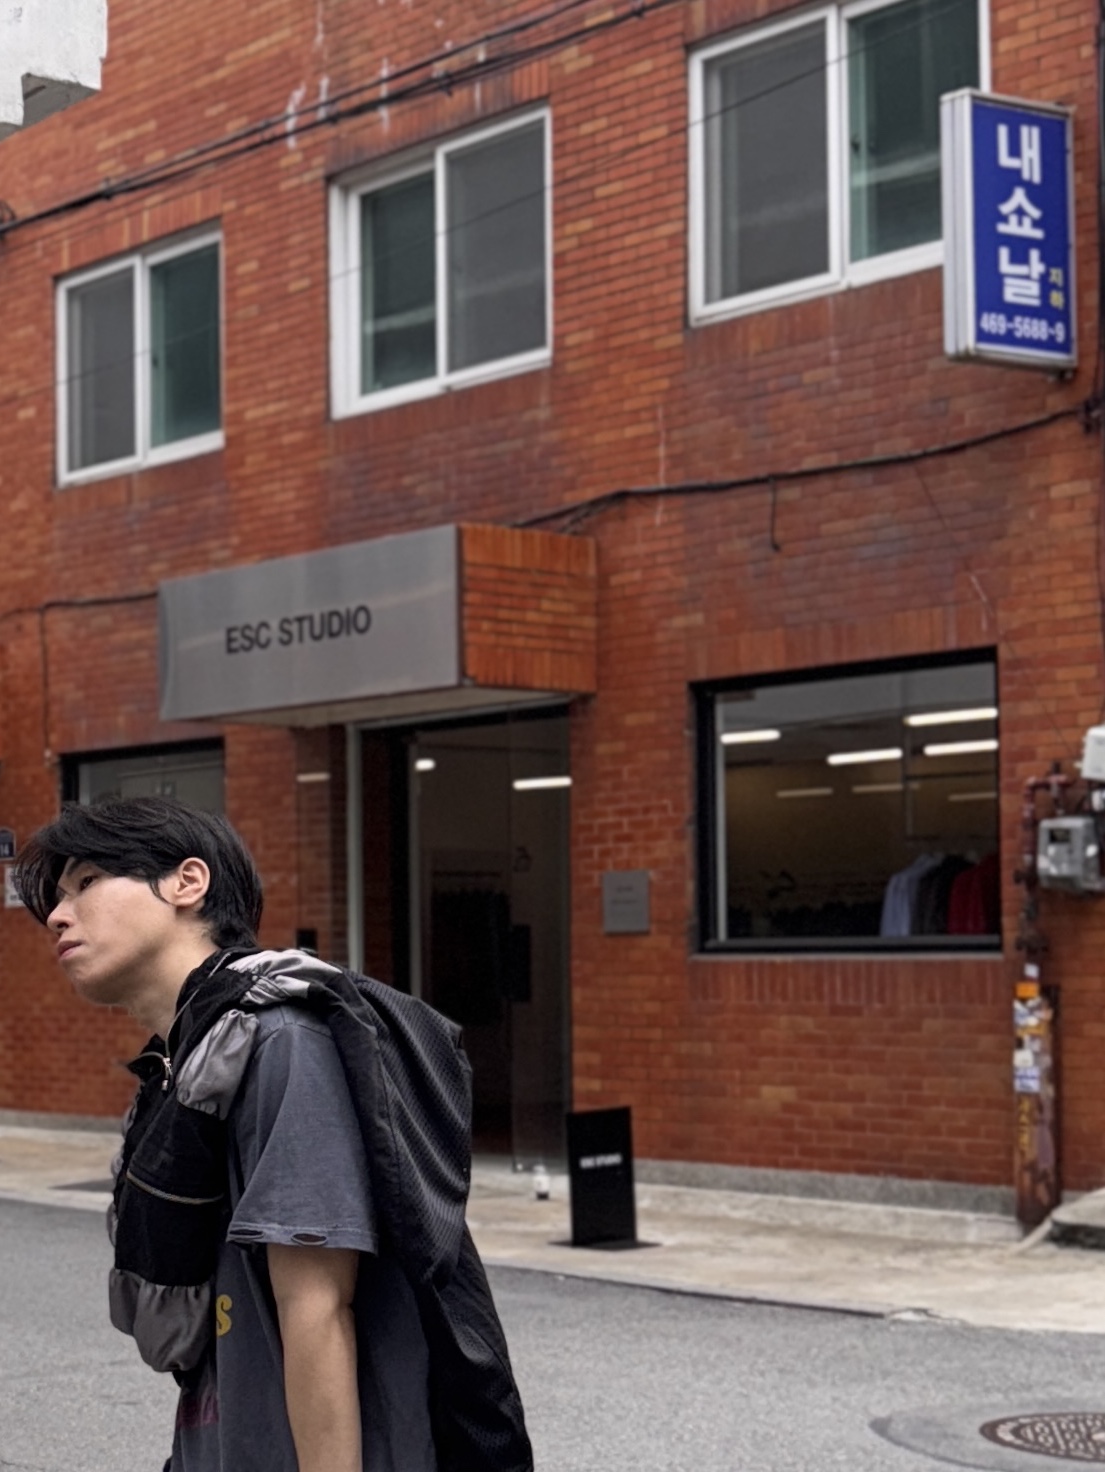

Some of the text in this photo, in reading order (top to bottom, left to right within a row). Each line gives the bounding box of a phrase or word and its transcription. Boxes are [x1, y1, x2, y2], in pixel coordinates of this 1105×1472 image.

[996, 122, 1046, 307] 내쇼날
[225, 604, 371, 655] ESC STUDIO
